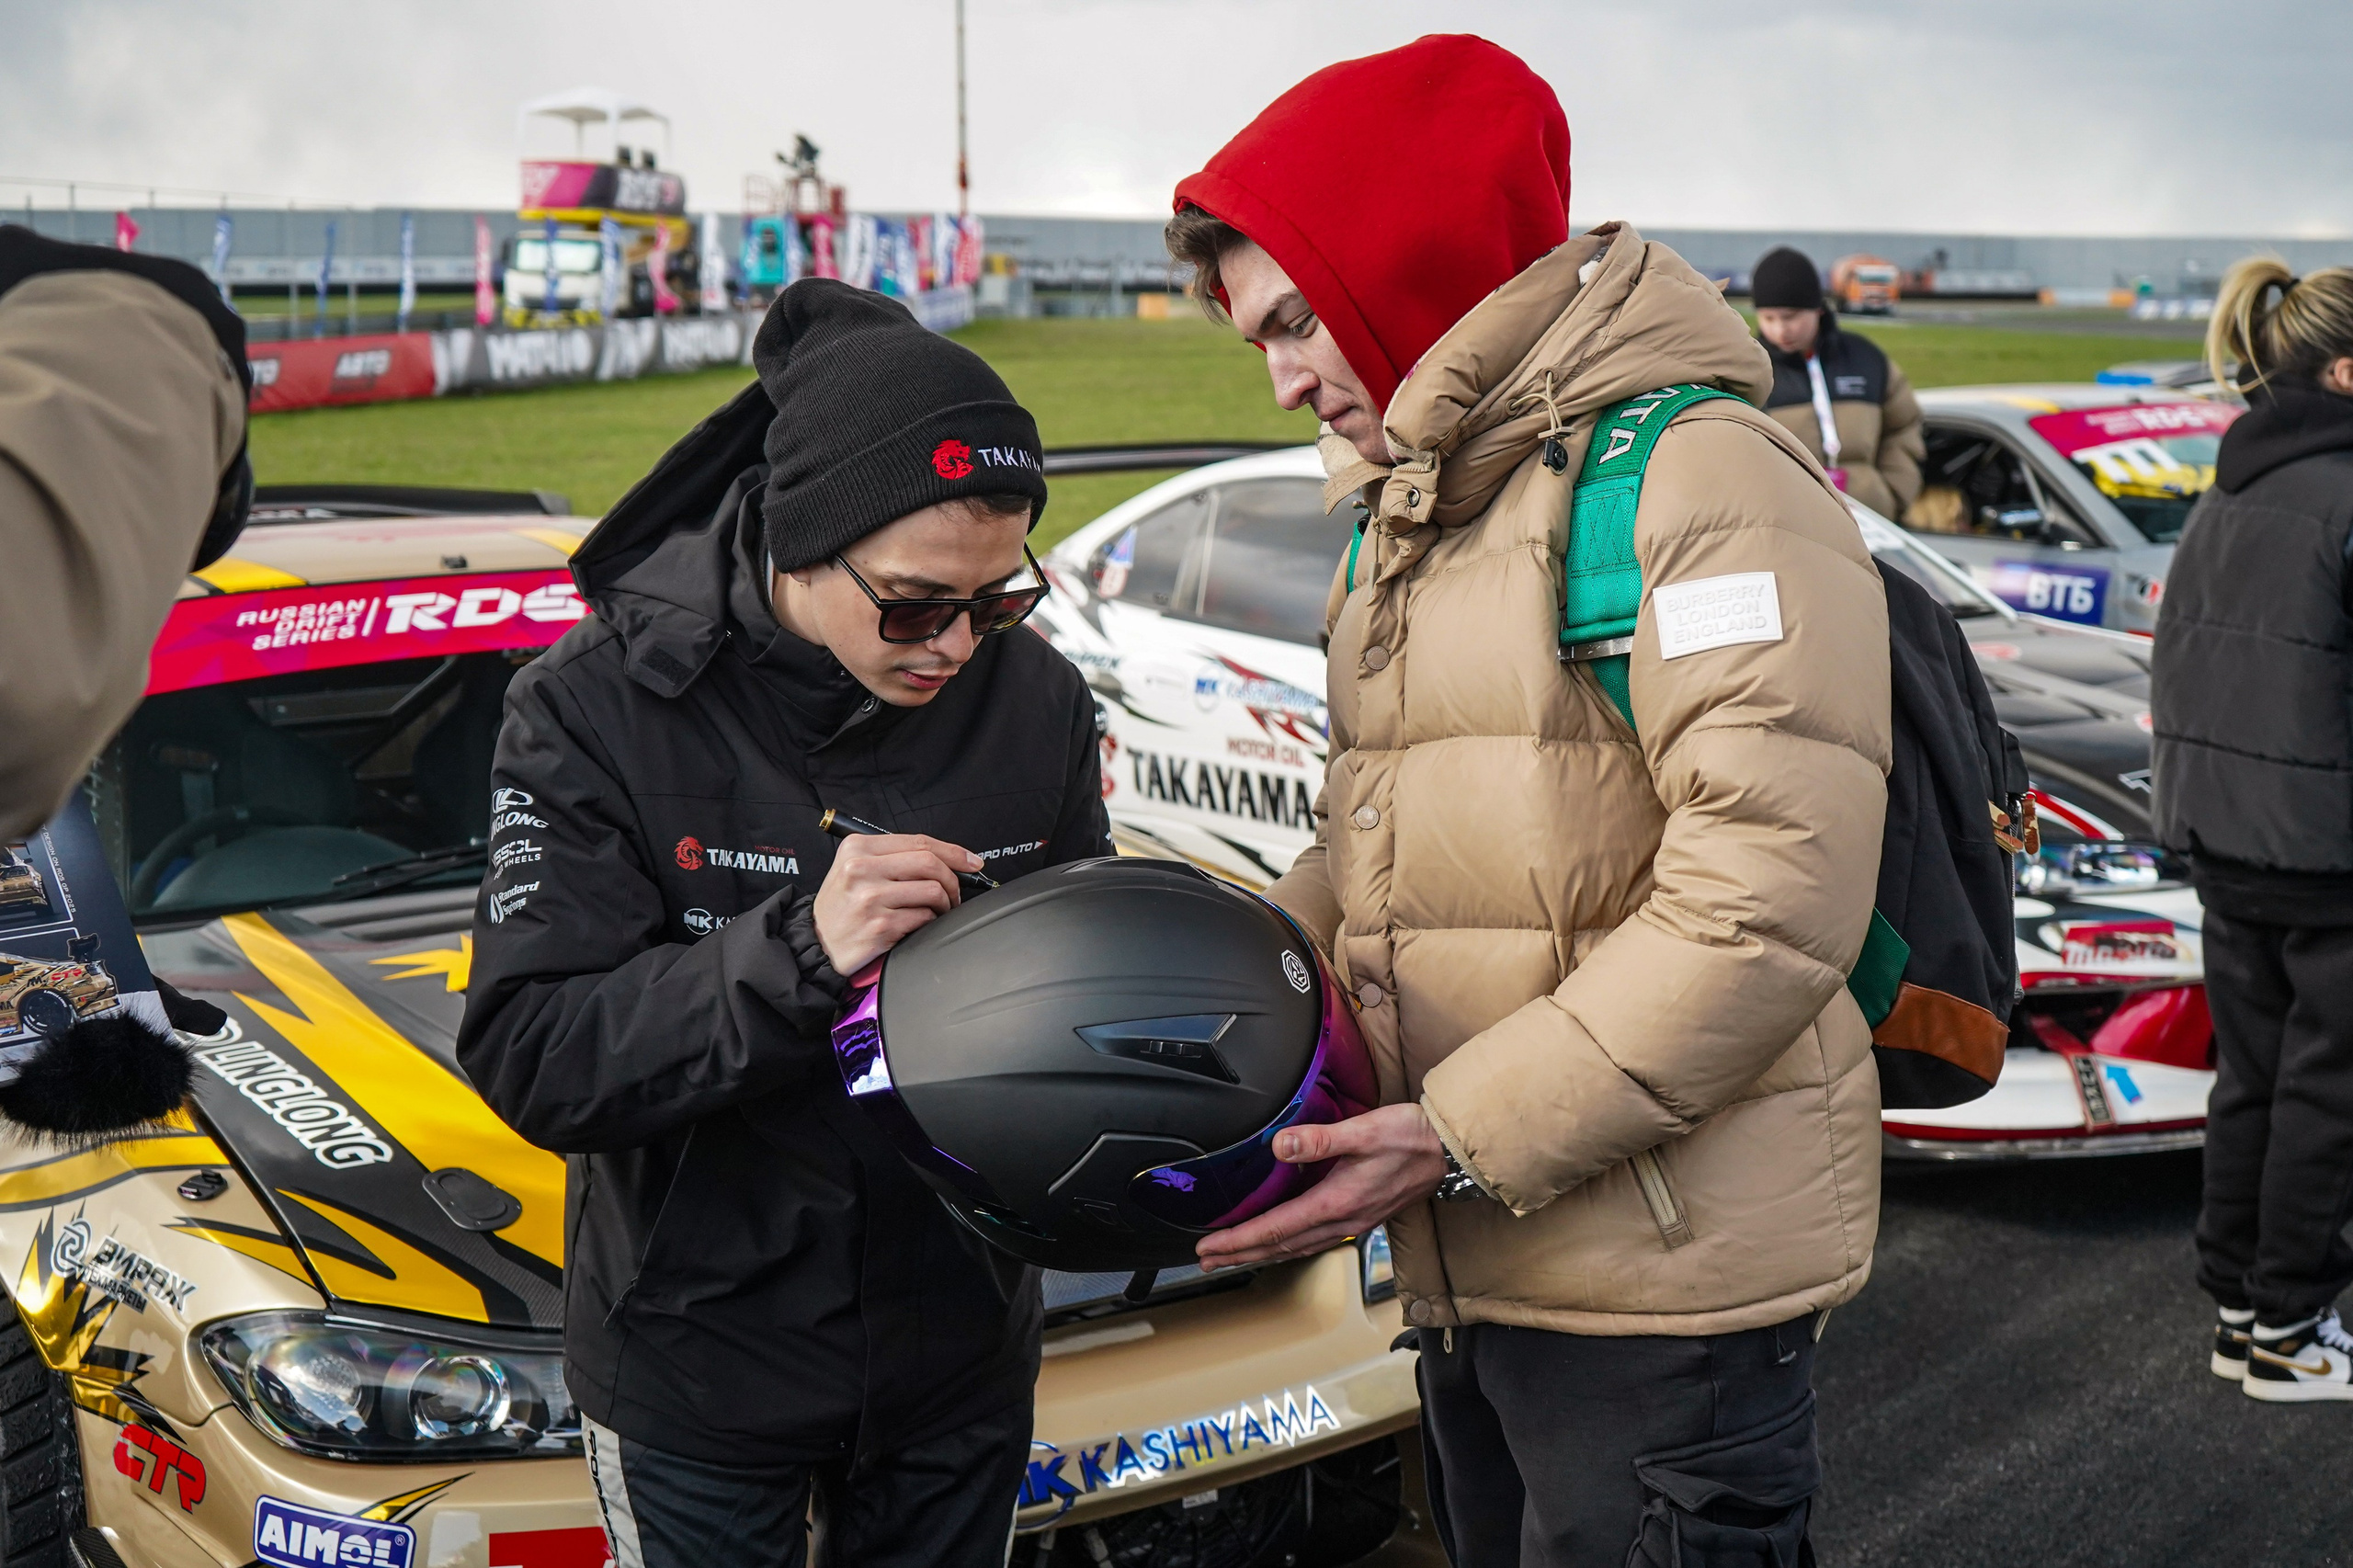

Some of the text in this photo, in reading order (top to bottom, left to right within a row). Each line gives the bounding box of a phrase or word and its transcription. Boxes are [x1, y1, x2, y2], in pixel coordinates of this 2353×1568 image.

[1667, 584, 1765, 613] BURBERRY
[2026, 572, 2097, 615] ВТБ
[236, 597, 367, 627] RUSSIAN
[274, 612, 361, 634] DRIFT
[385, 583, 586, 634] RDS
[1677, 599, 1760, 627] LONDON
[252, 624, 356, 651] SERIES
[1675, 615, 1768, 643] ENGLAND
[1227, 737, 1305, 767] MOTOR OIL
[1126, 746, 1317, 832] TAKAYAMA
[504, 853, 541, 869] WHEELS
[706, 848, 800, 875] TAKAYAMA
[755, 845, 796, 856] MOTOR OIL
[1002, 842, 1033, 857] AUTO
[42, 832, 56, 856] DESIGN
[51, 857, 60, 867] ON
[65, 893, 77, 914] 2025
[497, 881, 540, 903] Standard
[503, 897, 527, 915] Springs
[683, 912, 713, 930] MK
[193, 1039, 393, 1169] LINGLONG
[92, 1234, 198, 1315] ВИРАЖ
[1079, 1384, 1342, 1494] KASHIYAMA
[113, 1423, 207, 1515] CTR
[259, 1514, 400, 1568] AIMOL
